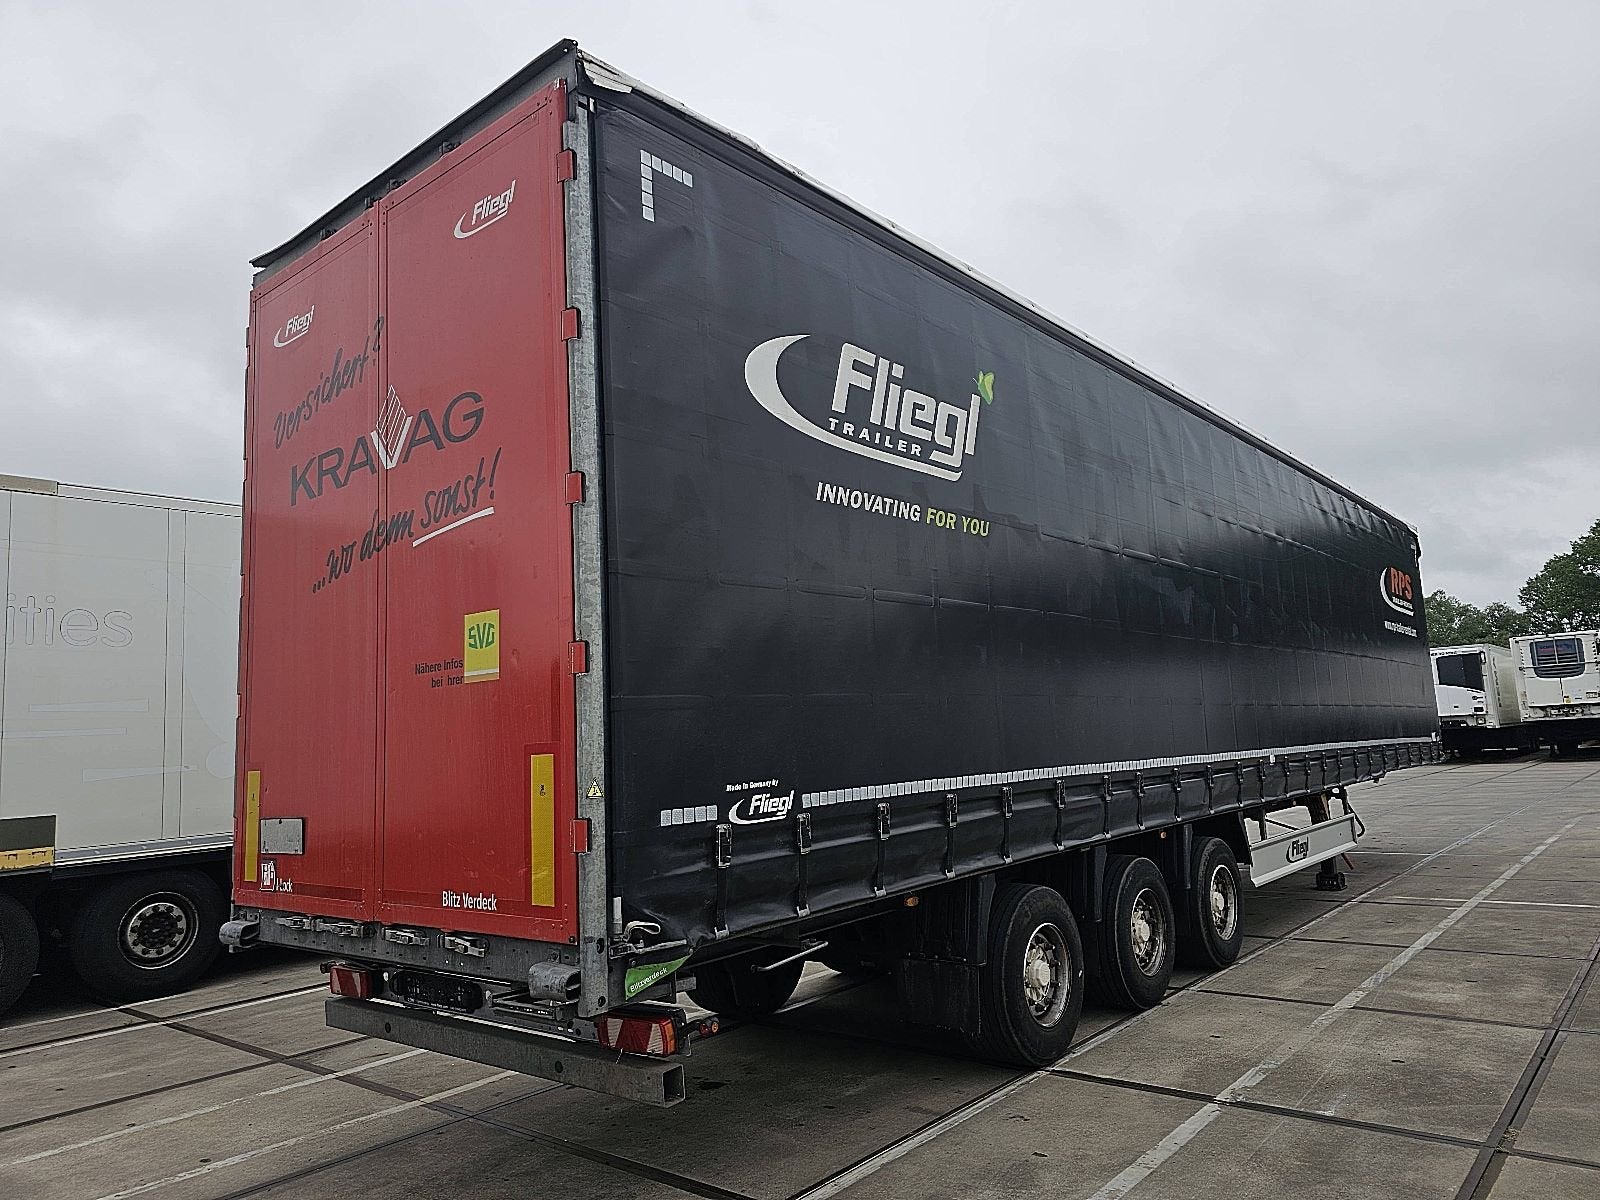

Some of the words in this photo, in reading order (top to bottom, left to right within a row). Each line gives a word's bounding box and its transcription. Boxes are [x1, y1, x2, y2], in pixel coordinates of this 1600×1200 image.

[471, 179, 516, 225] Fliegl
[285, 304, 316, 338] Fliegl
[831, 342, 981, 468] Fliegl
[290, 390, 484, 506] KRAVAG
[828, 417, 922, 457] TRAILER
[360, 509, 414, 562] denn
[421, 447, 501, 528] sonst!
[816, 481, 921, 522] INNOVATING
[926, 507, 956, 530] FOR
[961, 515, 990, 537] YOU
[1391, 567, 1413, 600] RPS
[468, 622, 496, 650] SVG
[415, 662, 442, 675] Nähere
[444, 658, 464, 671] Infos
[431, 676, 443, 688] bei
[447, 674, 464, 686] hrer
[749, 790, 795, 816] Fliegl
[442, 890, 461, 908] Blitz
[462, 892, 497, 911] Verdeck
